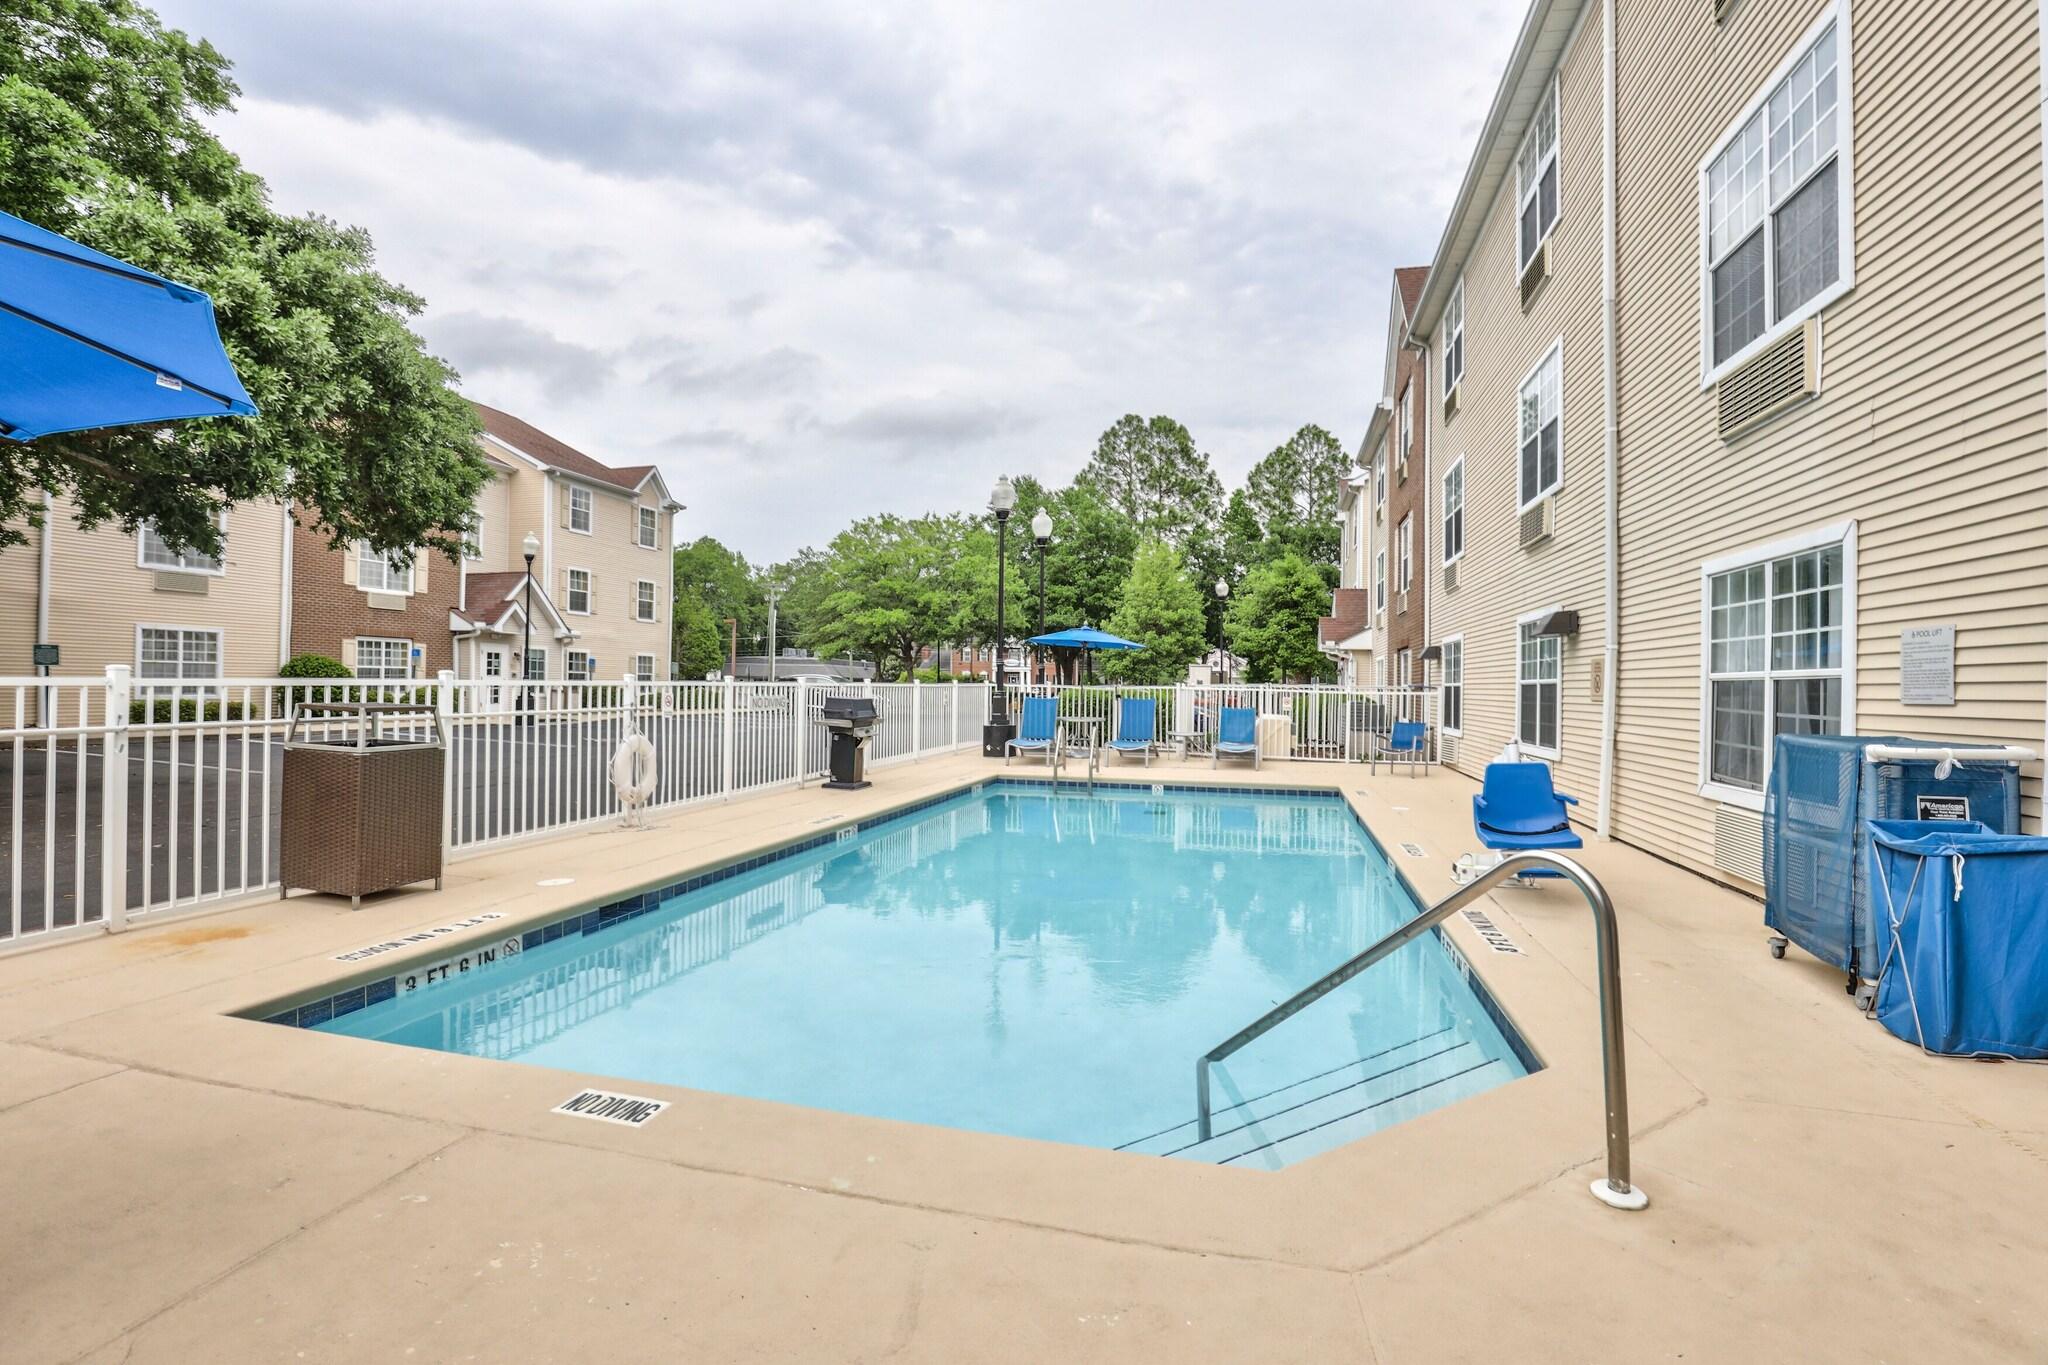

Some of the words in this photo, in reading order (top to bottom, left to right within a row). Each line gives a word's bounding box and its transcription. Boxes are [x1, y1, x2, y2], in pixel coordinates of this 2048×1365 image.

[752, 697, 763, 708] NO
[764, 697, 786, 708] DIVING
[1930, 802, 1964, 810] American
[427, 963, 449, 985] FT
[478, 948, 496, 967] IN
[560, 1092, 603, 1112] NO
[585, 1096, 662, 1123] DIVING
